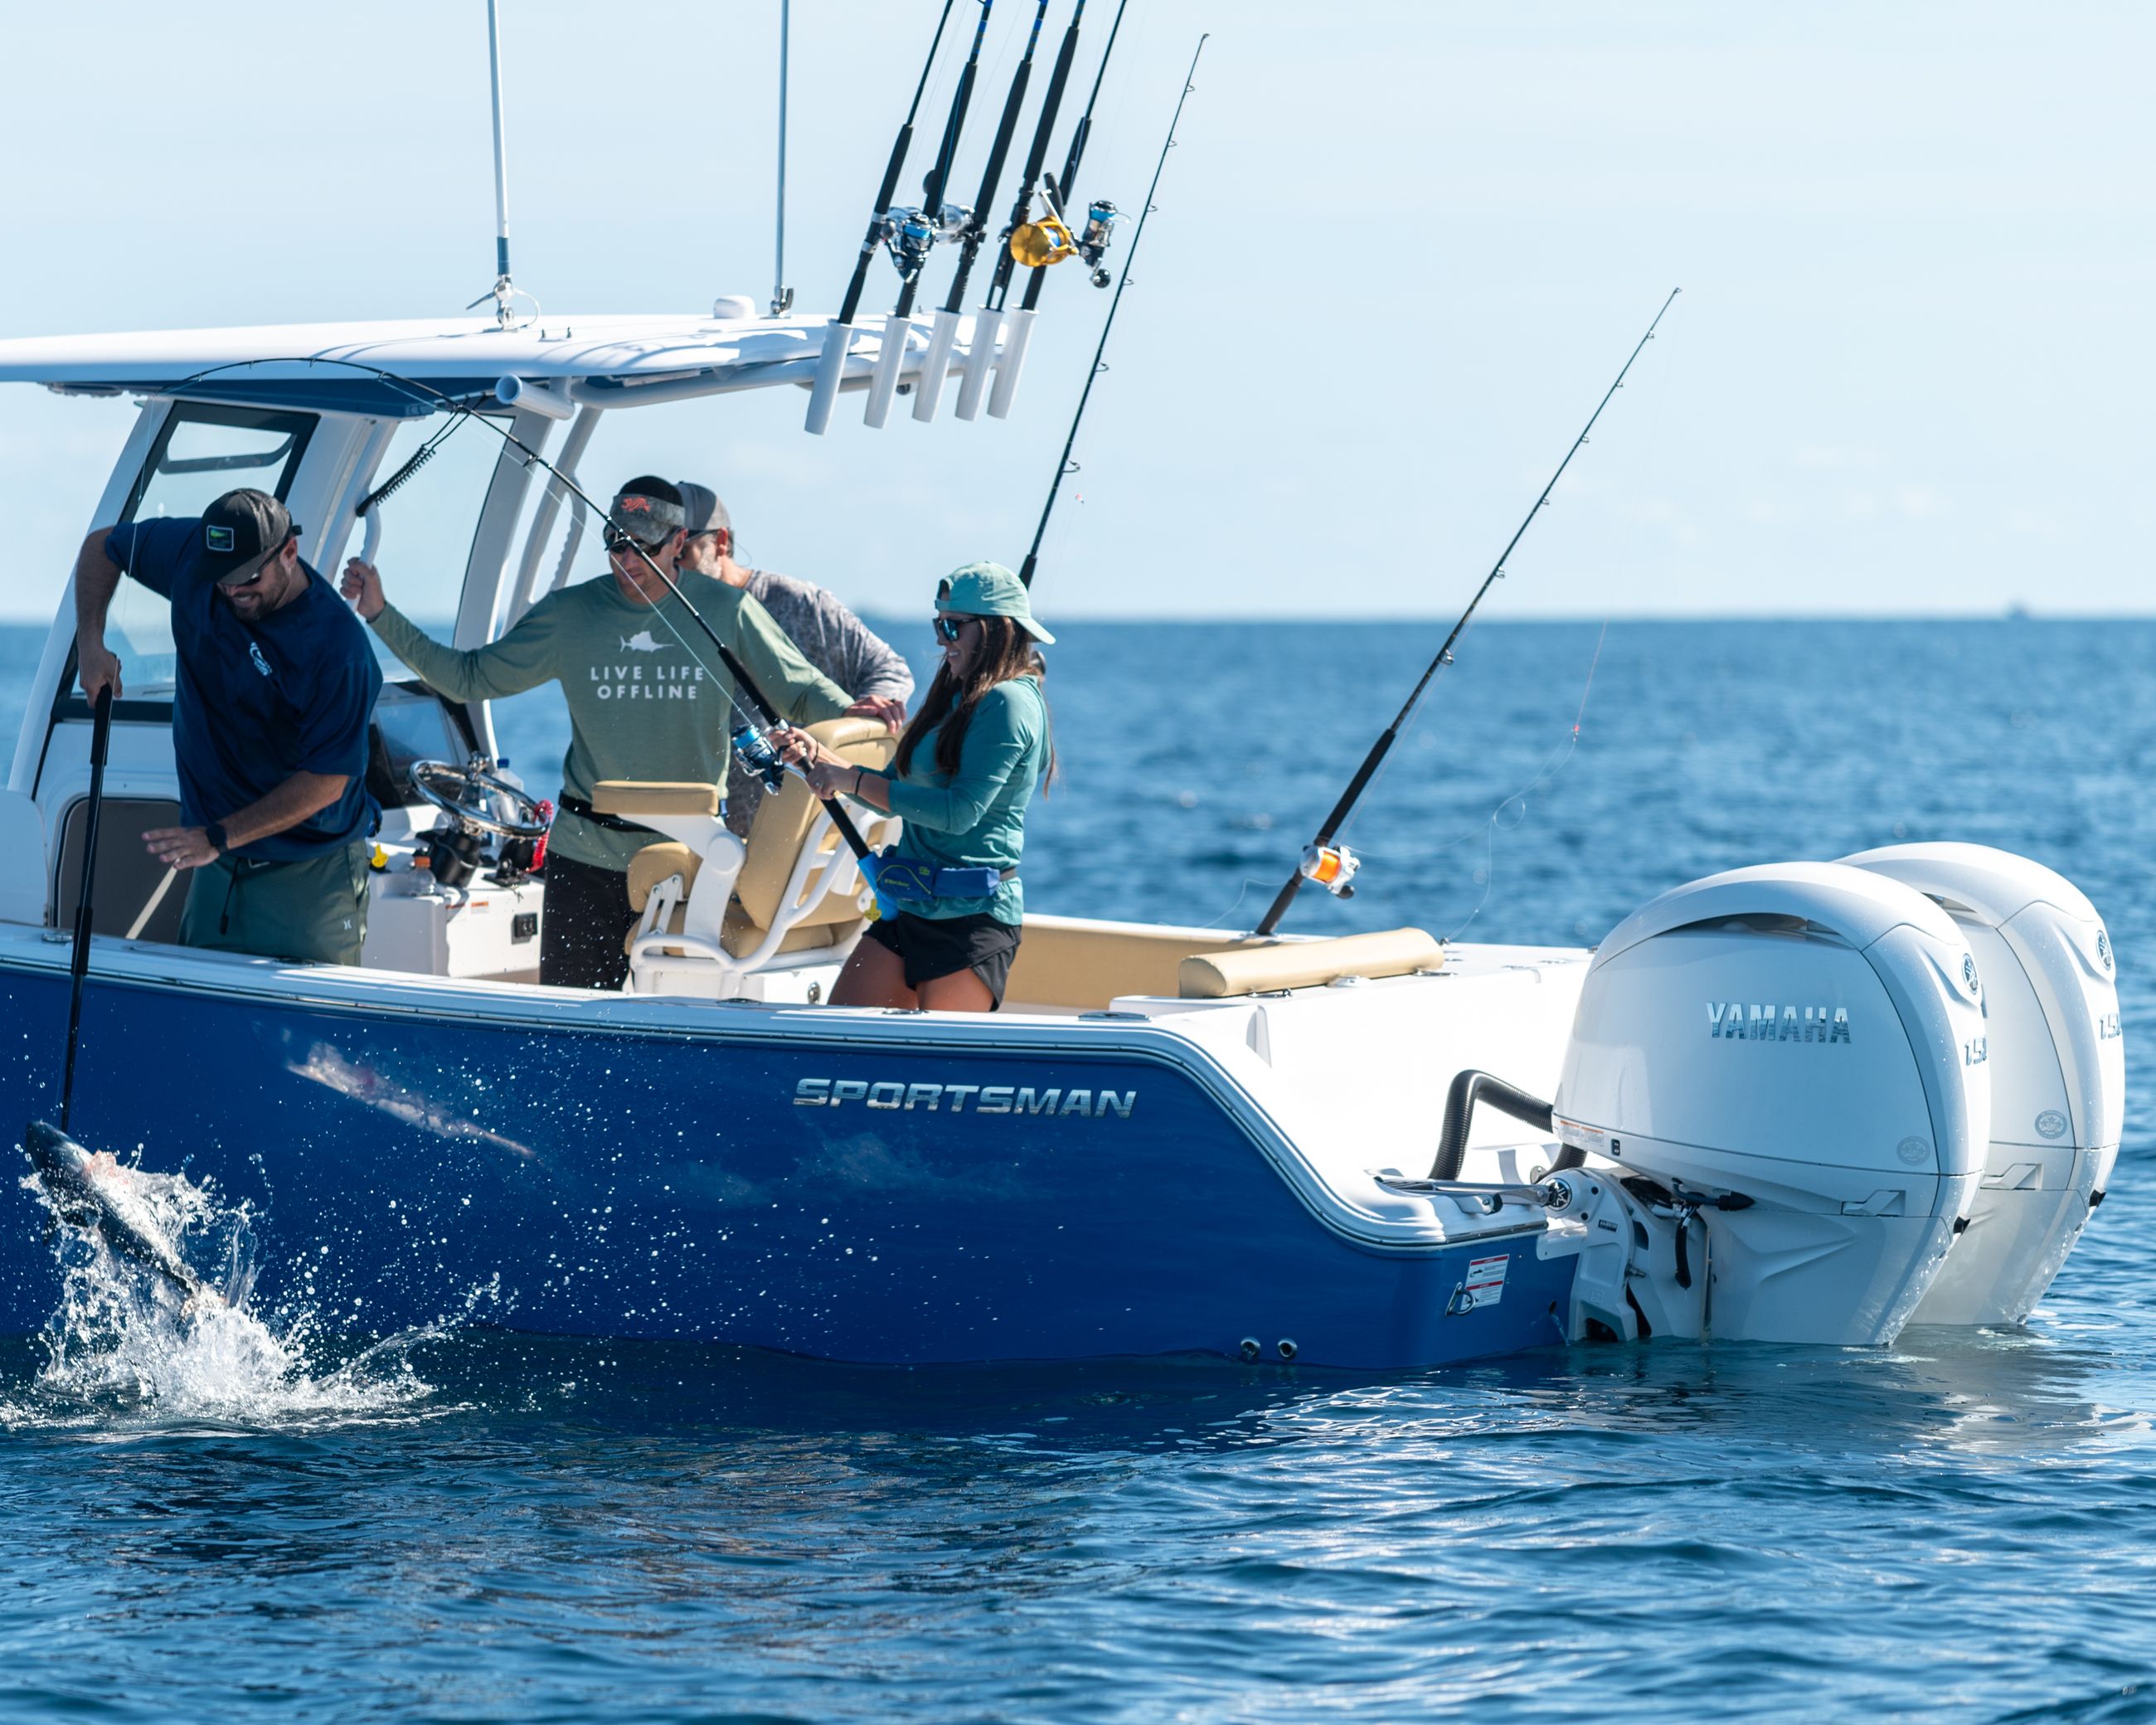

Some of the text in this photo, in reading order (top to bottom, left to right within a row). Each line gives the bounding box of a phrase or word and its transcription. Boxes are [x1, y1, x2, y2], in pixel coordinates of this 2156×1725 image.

[590, 666, 703, 681] LIVE LIFE
[597, 685, 697, 699] OFFLINE
[1706, 1002, 1852, 1043] YAMAHA
[793, 1077, 1138, 1119] SPORTSMAN
